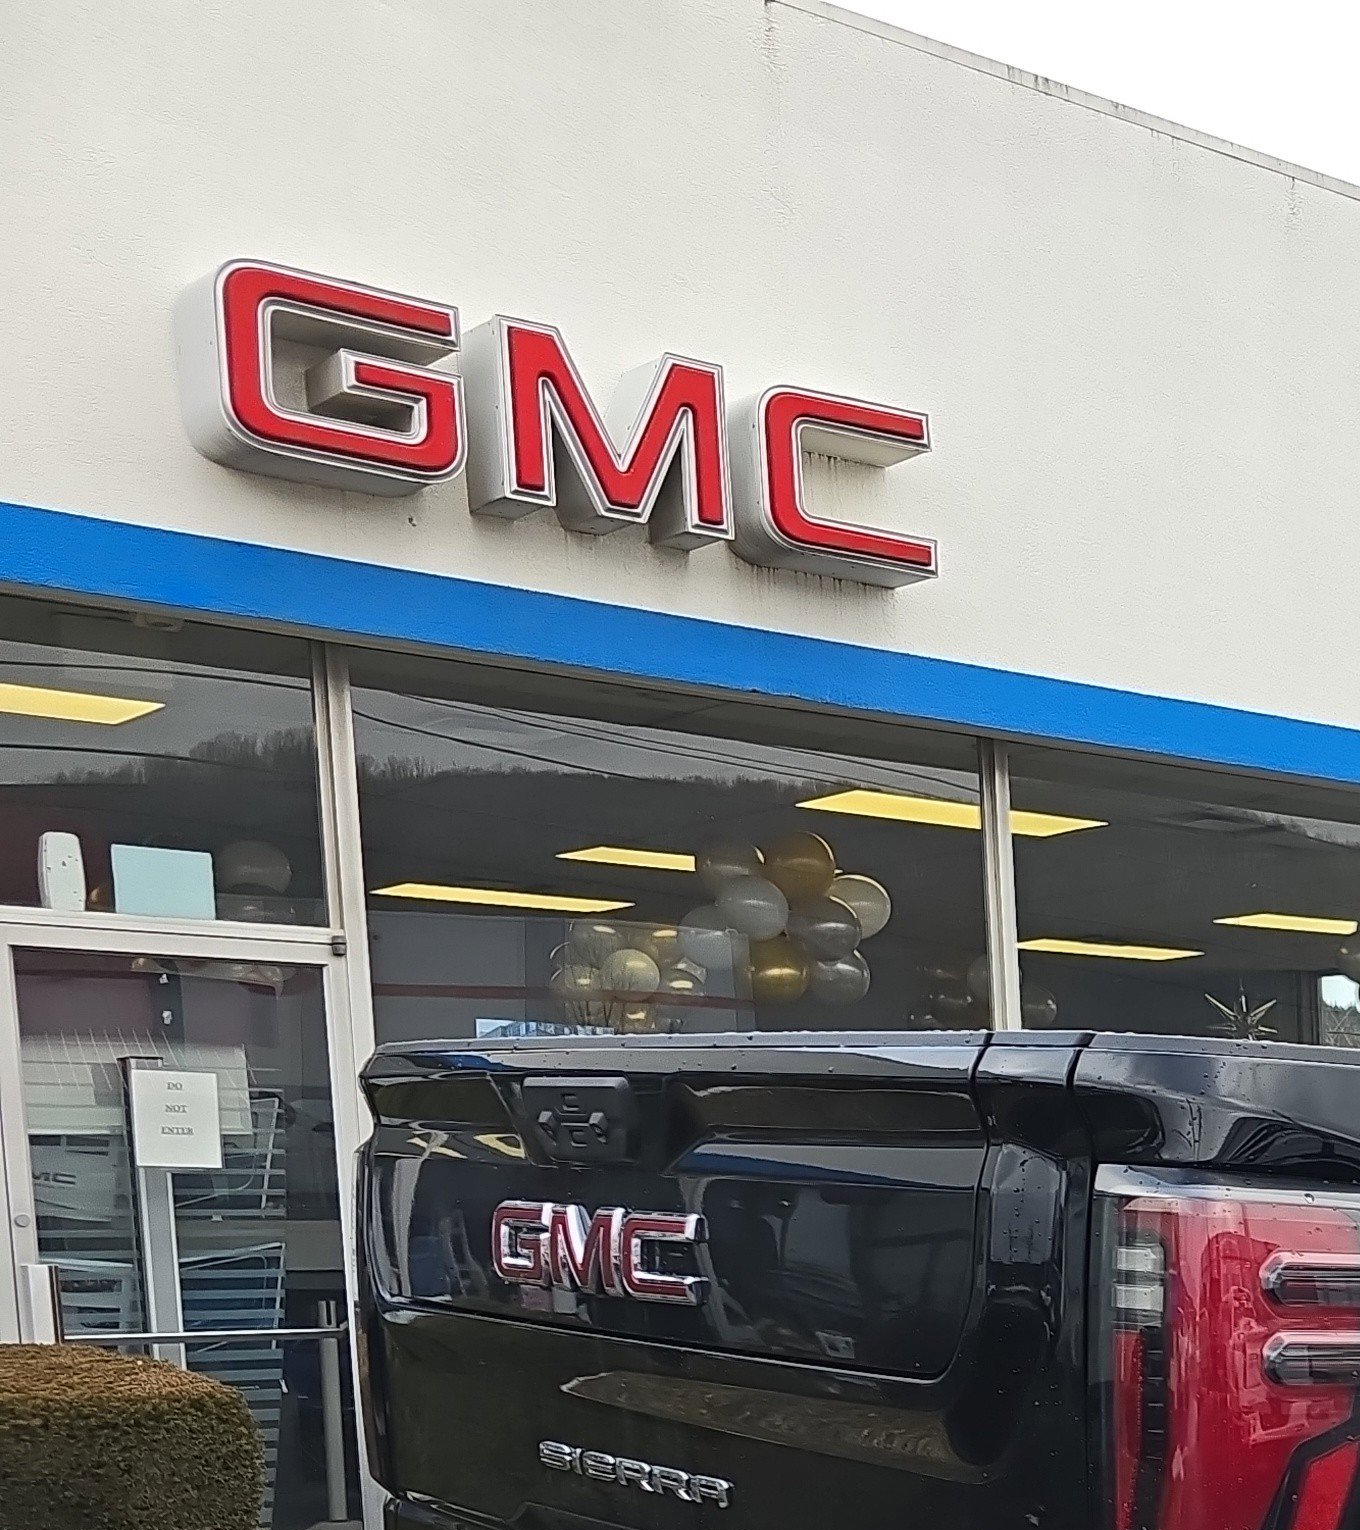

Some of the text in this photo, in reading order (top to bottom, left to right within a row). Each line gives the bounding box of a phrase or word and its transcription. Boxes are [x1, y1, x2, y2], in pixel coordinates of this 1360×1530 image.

[212, 258, 938, 580] GMC
[166, 1081, 184, 1091] DO
[164, 1103, 189, 1114] NOT
[160, 1125, 195, 1136] ENTER
[491, 1199, 709, 1306] GMC
[538, 1439, 735, 1509] SIERRA
